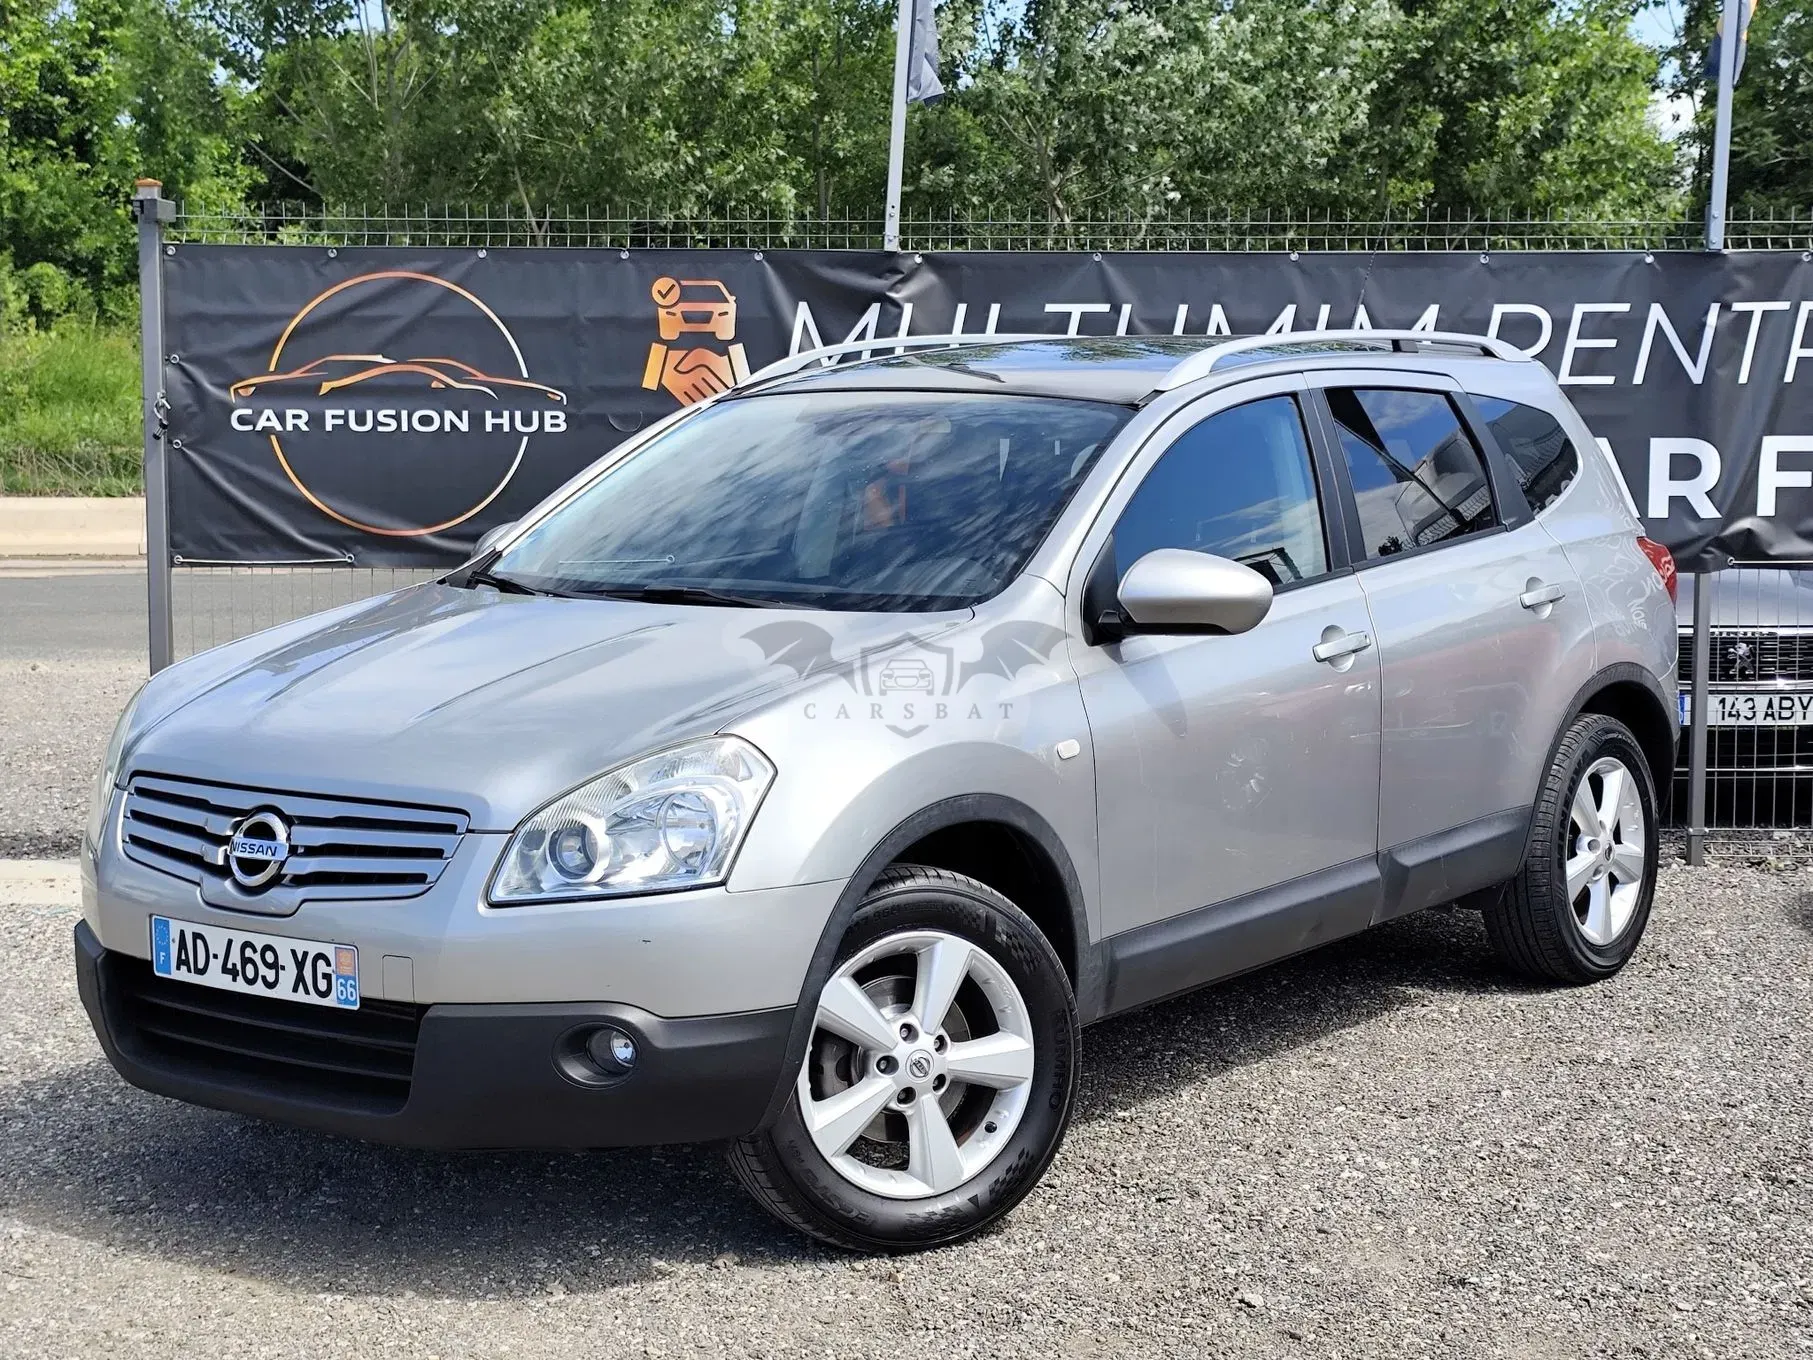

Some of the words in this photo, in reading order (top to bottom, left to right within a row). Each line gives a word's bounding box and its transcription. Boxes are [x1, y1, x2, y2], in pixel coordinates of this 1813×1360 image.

[230, 408, 310, 432] CAR
[324, 408, 469, 433] FUSION
[484, 410, 568, 433] HUB
[1717, 696, 1756, 721] 143
[1763, 696, 1813, 721] ABY
[230, 840, 278, 857] NISSAN
[159, 951, 166, 965] F
[175, 928, 333, 999] AD-469-XG
[337, 978, 357, 1001] 66
